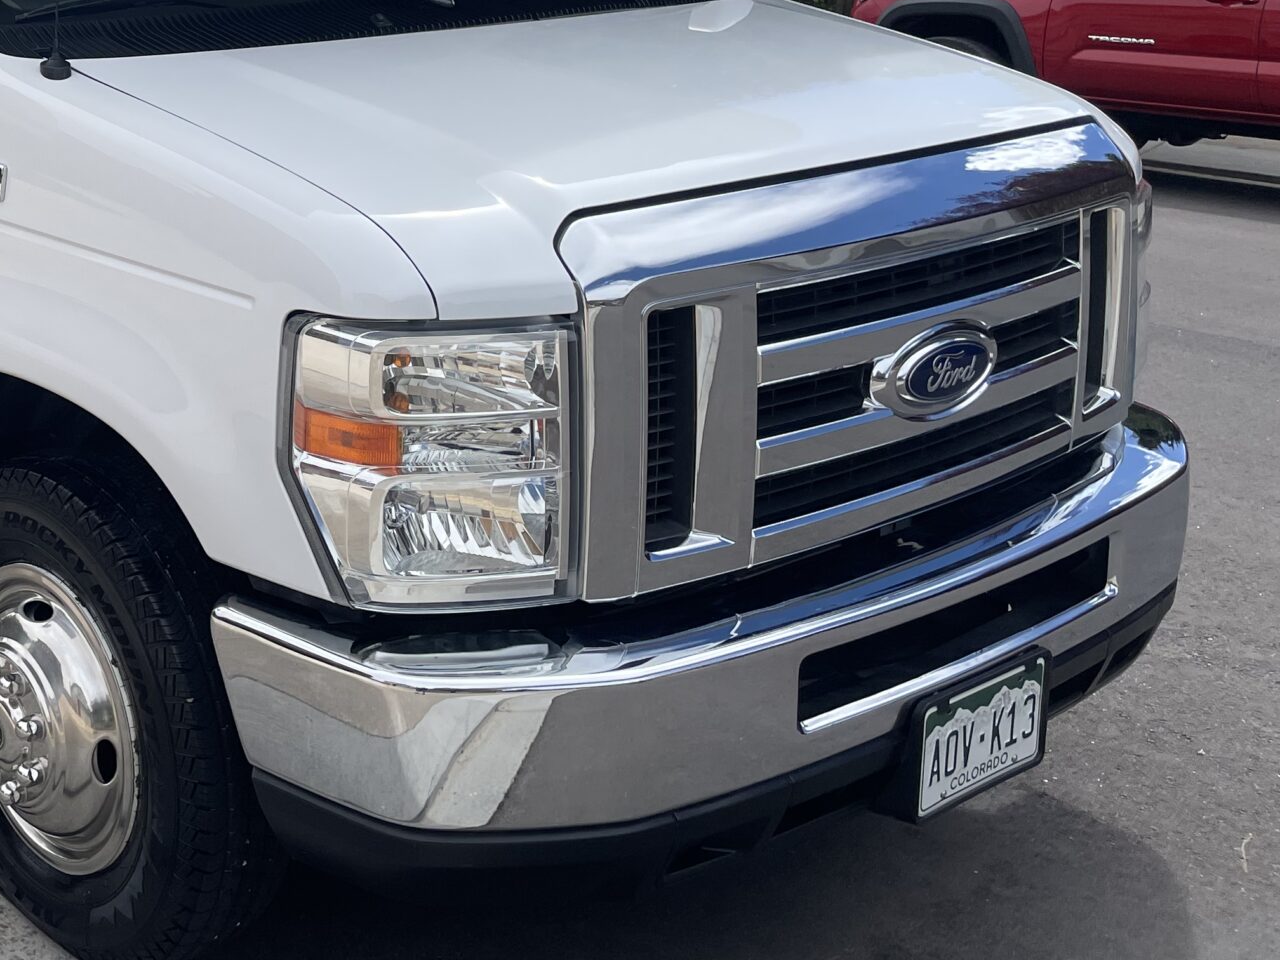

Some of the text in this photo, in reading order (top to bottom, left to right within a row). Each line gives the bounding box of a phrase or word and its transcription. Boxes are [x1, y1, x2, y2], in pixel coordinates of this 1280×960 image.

[1087, 34, 1155, 45] TACOMA
[927, 350, 977, 393] Ford
[3, 511, 93, 577] ROCKY
[949, 751, 1010, 790] COLORADO
